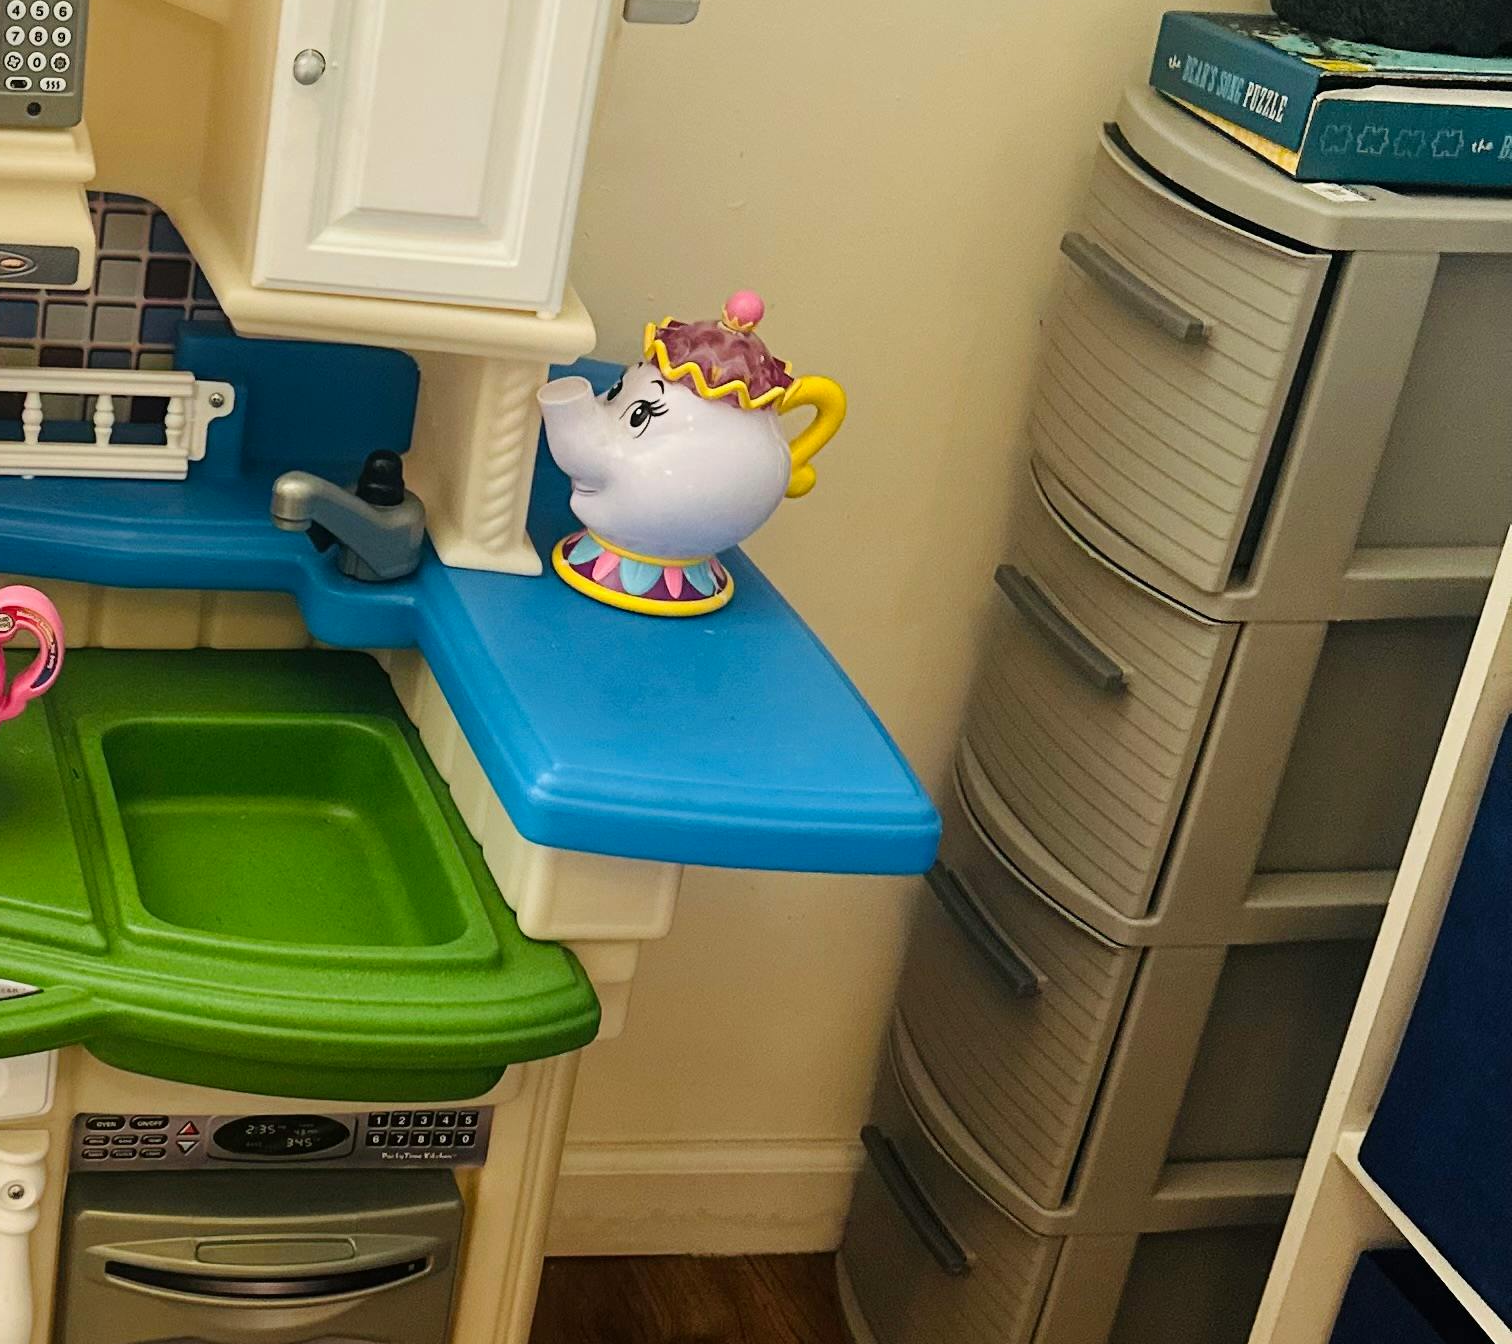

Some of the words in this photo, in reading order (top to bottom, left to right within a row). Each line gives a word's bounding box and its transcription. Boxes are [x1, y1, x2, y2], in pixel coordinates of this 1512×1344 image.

[11, 5, 20, 17] 4
[35, 5, 44, 17] 5
[59, 6, 67, 17] 6
[11, 31, 20, 42] 7
[34, 31, 43, 43] 8
[57, 32, 66, 43] 9
[32, 57, 41, 68] 0
[1242, 81, 1288, 123] PUZZLE
[1471, 137, 1493, 154] the
[398, 1116, 406, 1125] 2
[420, 1116, 428, 1125] 3
[442, 1116, 449, 1125] 4
[465, 1116, 472, 1125] 5
[245, 1124, 276, 1135] 2:35
[372, 1135, 379, 1143] 6
[397, 1135, 404, 1143] 7
[417, 1135, 425, 1143] 8
[439, 1135, 446, 1143] 9
[462, 1135, 469, 1143] 0
